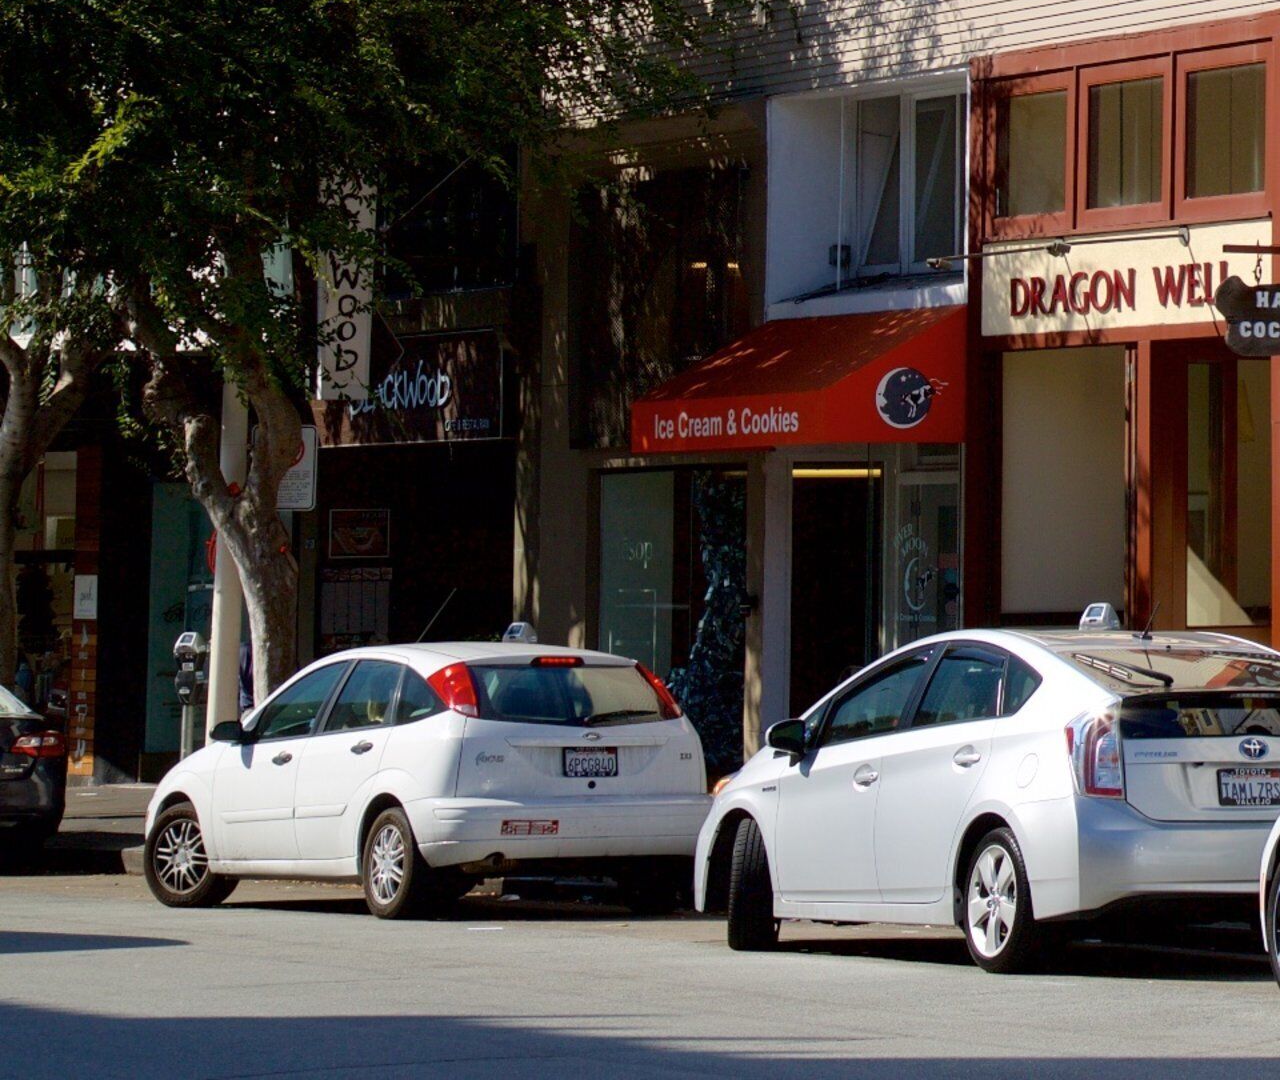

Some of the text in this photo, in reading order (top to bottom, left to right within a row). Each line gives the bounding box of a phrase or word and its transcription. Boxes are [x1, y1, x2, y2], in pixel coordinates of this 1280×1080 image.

[1010, 267, 1137, 318] DRAGON
[654, 408, 799, 440] Ice Cream & Cookies
[567, 756, 614, 771] 6PCG840
